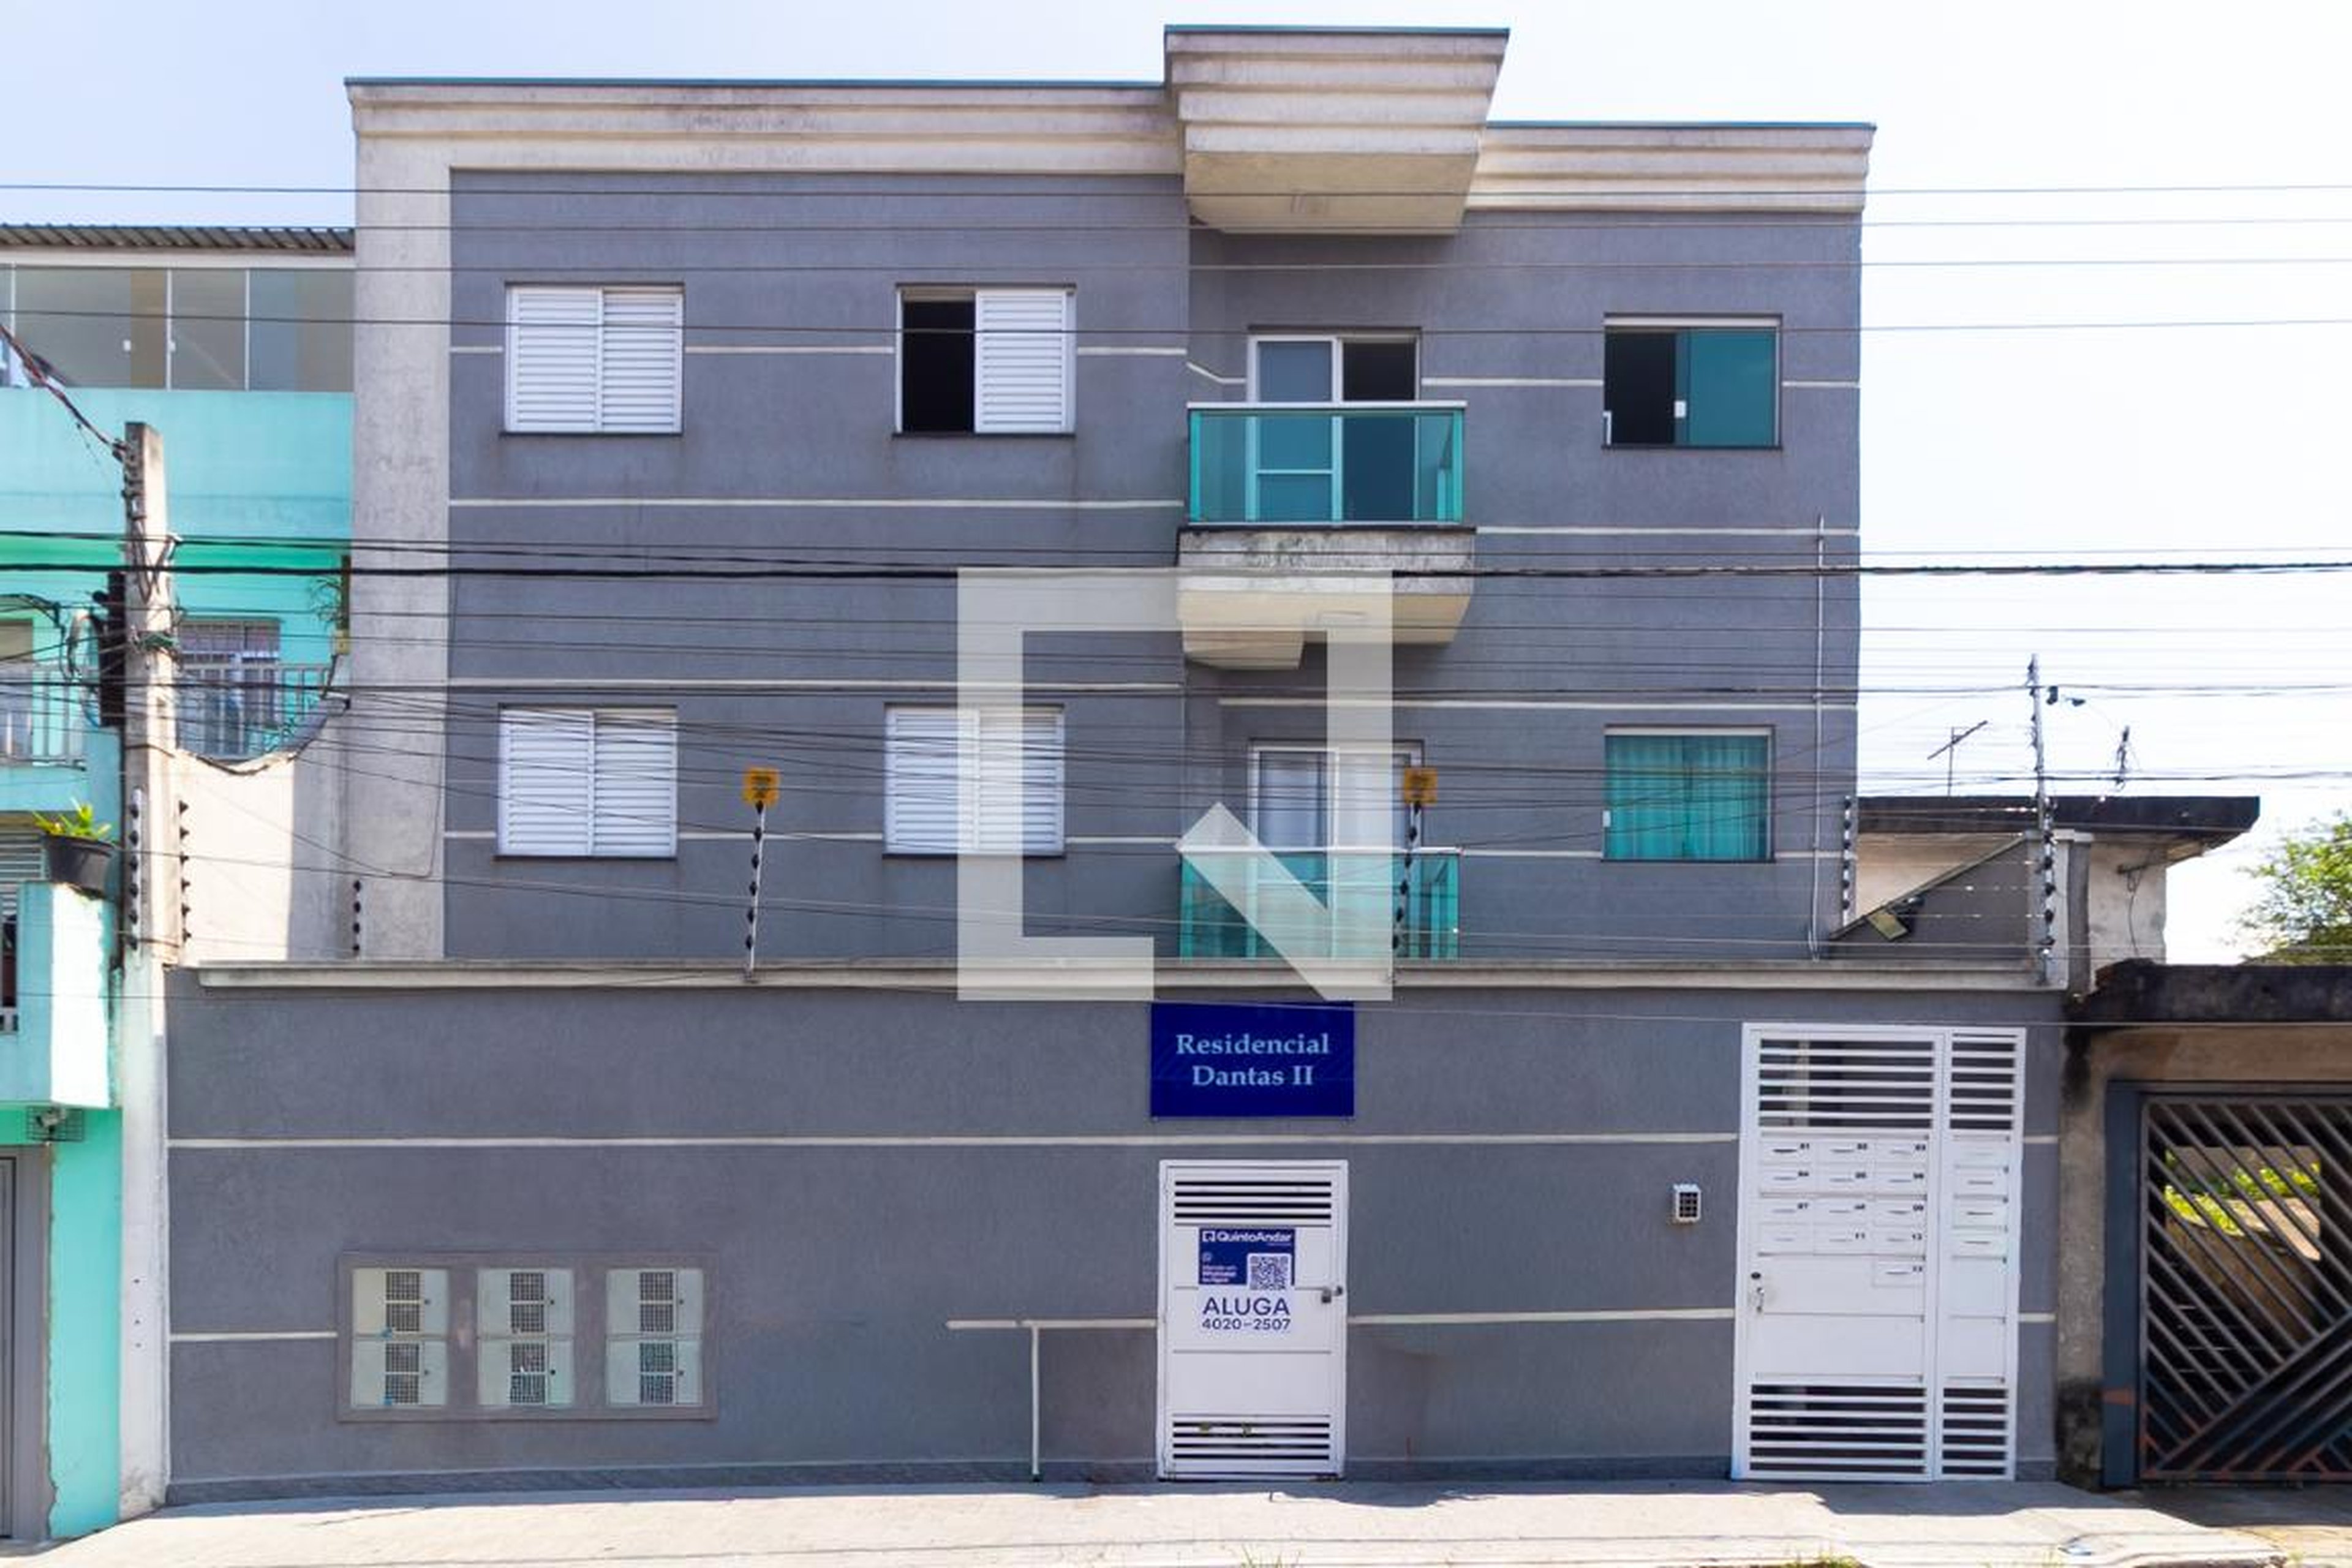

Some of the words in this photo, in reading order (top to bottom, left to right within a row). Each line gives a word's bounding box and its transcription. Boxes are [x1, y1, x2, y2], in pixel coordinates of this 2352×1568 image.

[1176, 1033, 1330, 1054] Residencial
[1193, 1065, 1284, 1086] Dantas
[1292, 1065, 1314, 1085] II
[1216, 1231, 1292, 1242] QuintoAndar
[1202, 1297, 1290, 1316] ALUGA
[1202, 1317, 1291, 1330] 4020-2507
